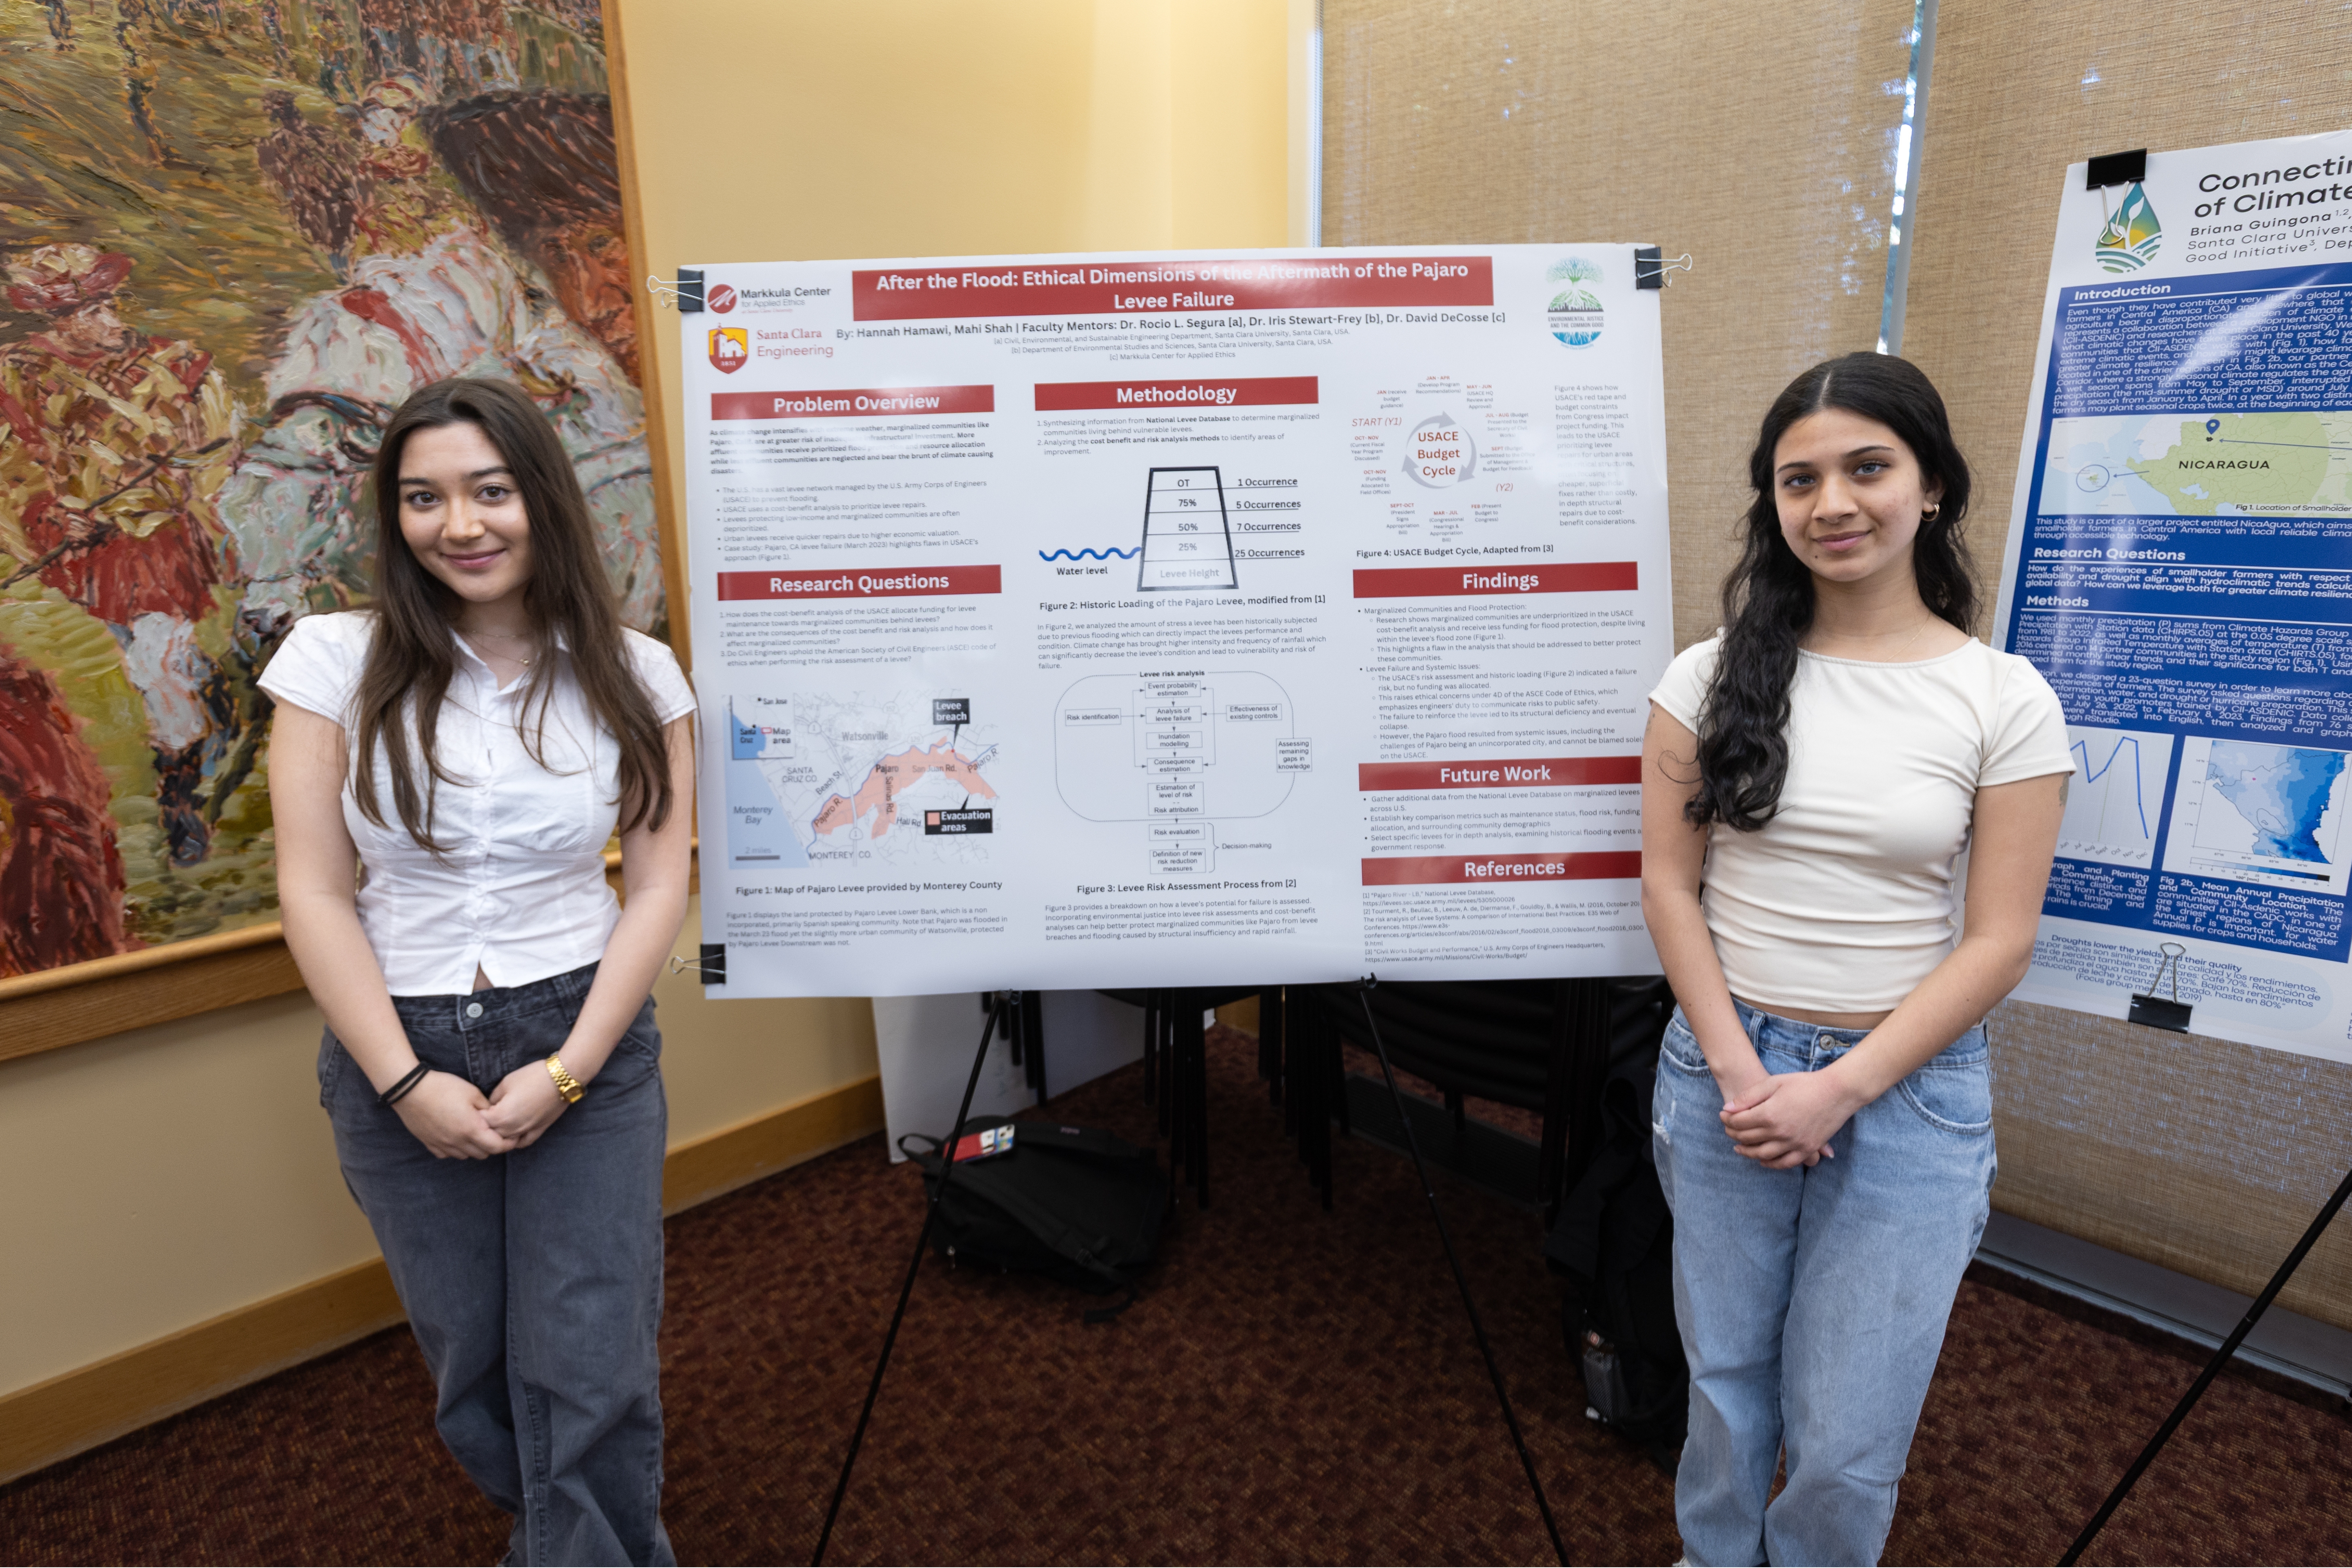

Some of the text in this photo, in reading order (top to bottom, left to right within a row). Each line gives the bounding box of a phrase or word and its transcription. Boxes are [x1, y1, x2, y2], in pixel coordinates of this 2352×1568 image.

[2194, 197, 2227, 218] of
[2190, 212, 2332, 236] Briana Guingona
[2188, 237, 2235, 250] Santa
[2241, 232, 2287, 244] Clara
[877, 262, 1468, 290] After the Flood: Ethical Dimensions of the Aftermath of the Pajaro
[741, 287, 831, 298] Markkula Center
[2074, 284, 2171, 300] Introduction
[1114, 291, 1234, 309] Levee Failure
[837, 312, 1505, 340] By: Hannah Hamawi, Mahi Shah Faculty Mentors: Dr. Rocio L. Segura [a], Dr. Iris Stewart-Frey [b], Dr. David DeCosse [c]
[757, 328, 822, 339] Santa Clara
[757, 346, 833, 359] Engineering
[1117, 385, 1237, 404] Methodology
[774, 394, 940, 412] Problem Overview
[1352, 417, 1402, 426] START (Y1)
[1418, 432, 1458, 442] USACE
[1418, 449, 1459, 461] Budget
[2179, 460, 2270, 469] NICARAGUA
[1423, 466, 1455, 478] Cycle
[1177, 479, 1190, 487] OT
[1496, 483, 1513, 492] (Y2)
[1236, 501, 1301, 509] 5 Occurrences
[1178, 523, 1198, 532] 50%
[1179, 543, 1197, 551] 25%
[1234, 549, 1245, 558] 25
[1356, 550, 1382, 559] Figure
[1424, 548, 1453, 557] Budget
[1455, 547, 1481, 556] Cycle,
[1483, 546, 1518, 555] Adapted
[1543, 544, 1553, 553] [3]
[2034, 547, 2186, 561] Research Questions
[770, 573, 949, 593] Research Questions
[1463, 572, 1539, 591] Findings
[2026, 595, 2089, 608] Methods
[935, 702, 962, 710] Levee
[936, 711, 967, 721] breach
[842, 731, 888, 742] Watsonville
[1441, 765, 1551, 783] Future Work
[940, 811, 991, 820] Evacuation
[1465, 860, 1565, 877] References
[736, 887, 763, 897] Figure
[775, 886, 794, 895] Map
[808, 886, 836, 895] Pajaro
[867, 883, 907, 893] provided
[910, 883, 921, 892] by
[923, 883, 967, 891] Monterey
[969, 881, 1002, 890] County
[2160, 876, 2344, 909] Fig 2b. Mean Annual Precipitation
[2052, 935, 2092, 947] Droughts
[2093, 940, 2117, 951] lower
[2119, 945, 2135, 953] the
[2136, 948, 2162, 958] yields
[2184, 955, 2207, 965] their
[2209, 960, 2242, 973] quality
